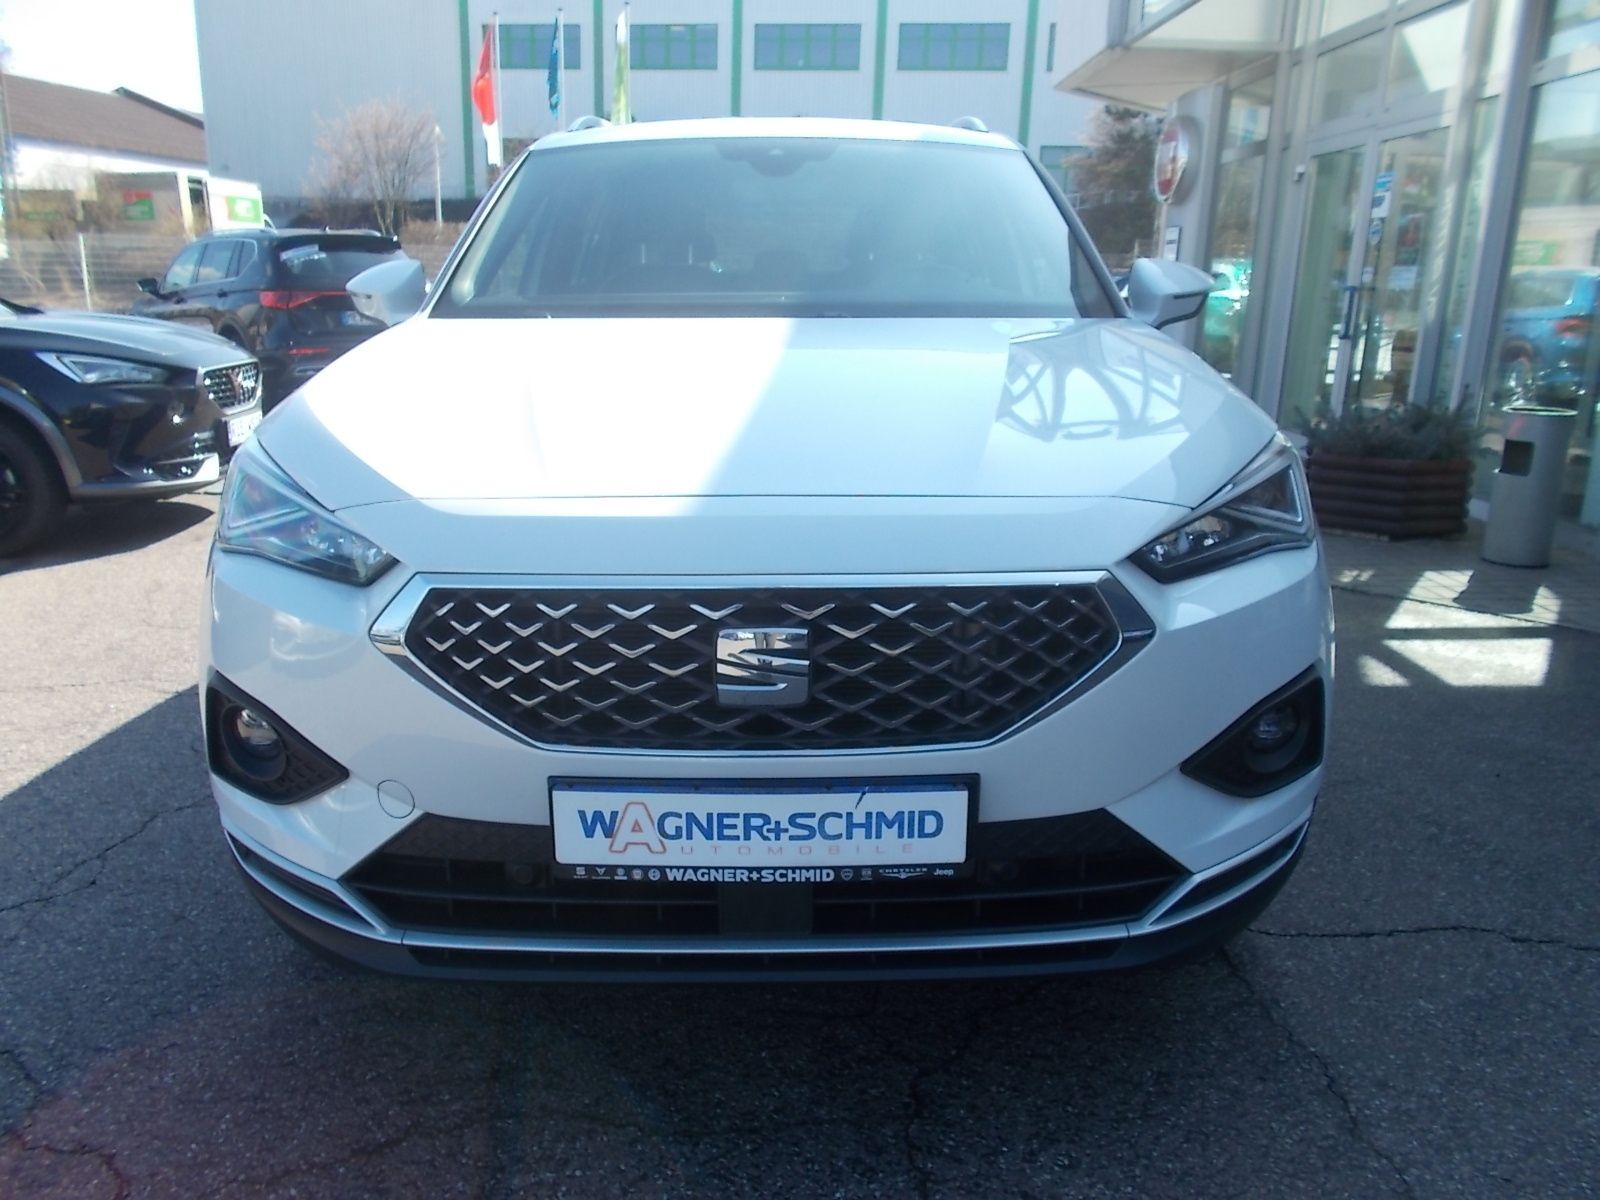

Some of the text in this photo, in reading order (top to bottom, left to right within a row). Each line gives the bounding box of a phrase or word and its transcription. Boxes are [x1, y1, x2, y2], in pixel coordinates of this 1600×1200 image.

[577, 802, 943, 853] WAGNER+SCHMID
[666, 868, 834, 882] WAGNER+SCHMID
[933, 868, 954, 877] Jeep
